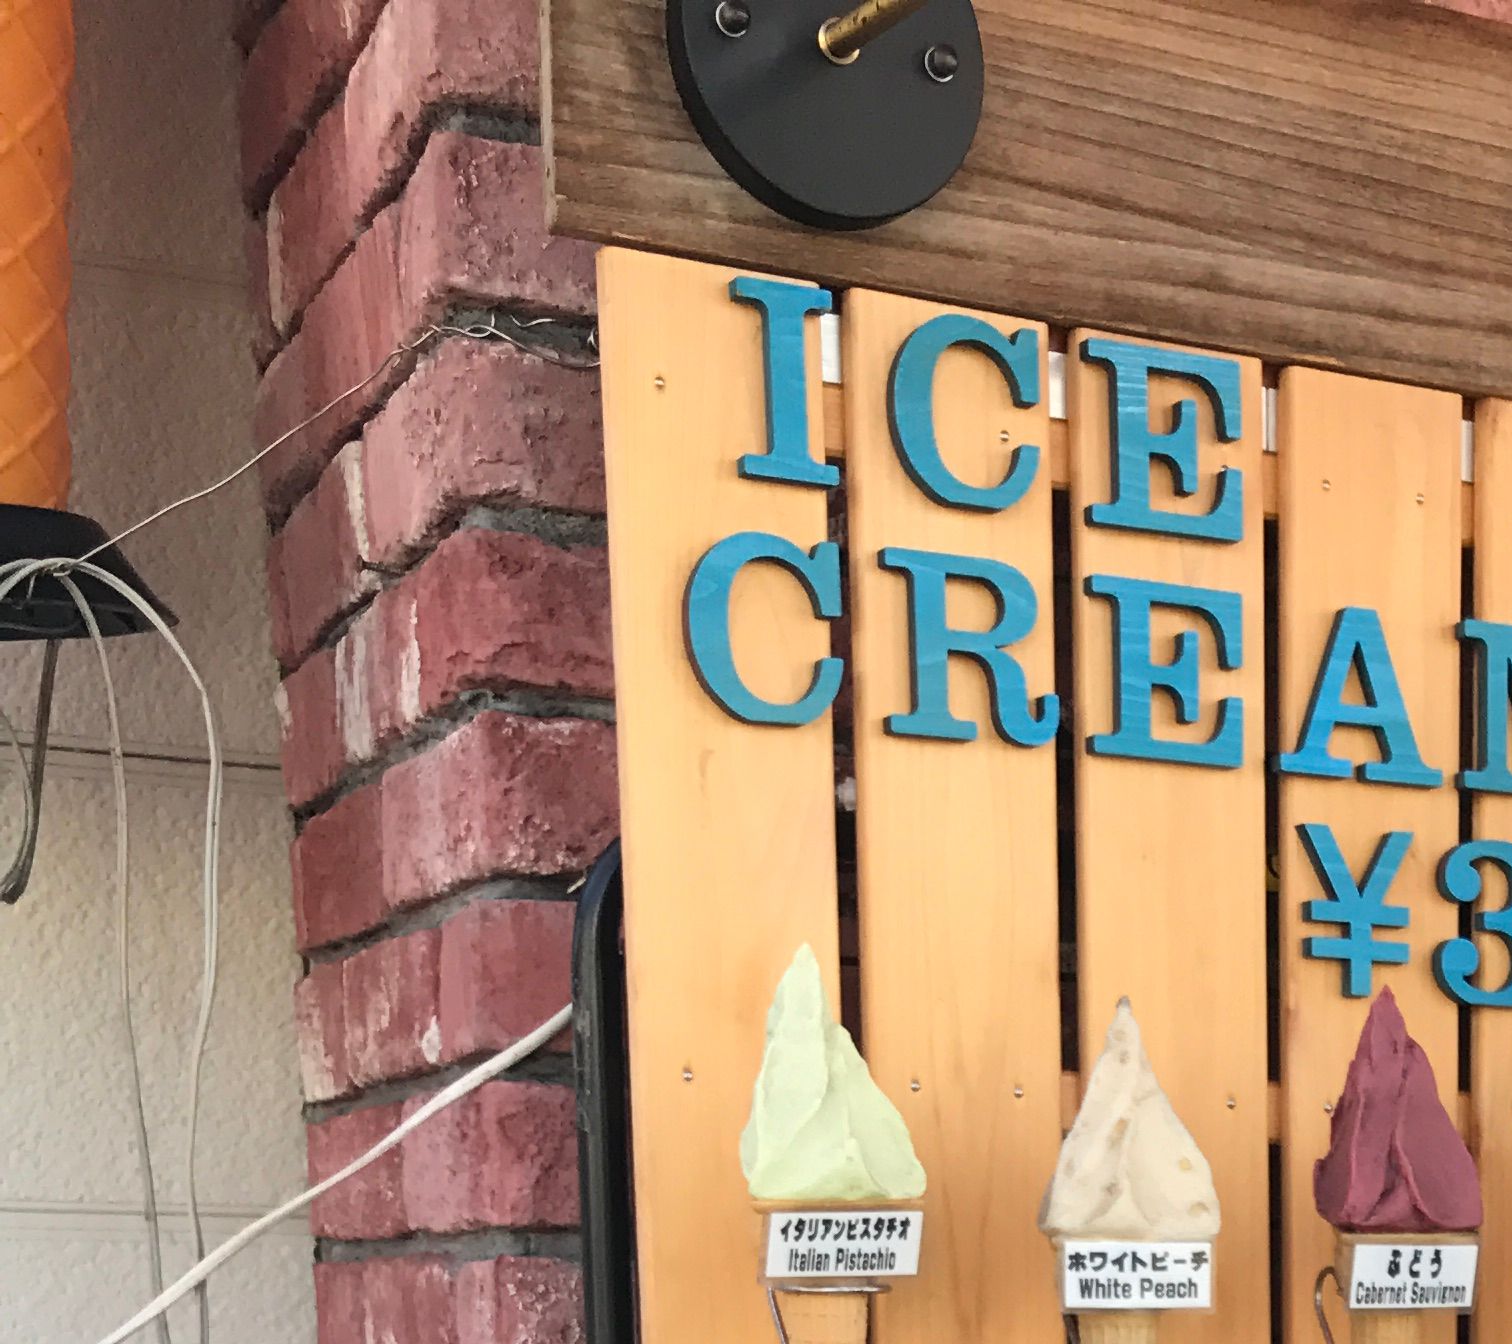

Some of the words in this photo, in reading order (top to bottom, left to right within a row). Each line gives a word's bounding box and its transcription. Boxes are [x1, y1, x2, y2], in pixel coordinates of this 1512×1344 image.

[729, 276, 1243, 545] ICE
[779, 1216, 912, 1244] イタリアンピスタチオ
[787, 1247, 831, 1272] Italian
[834, 1246, 897, 1272] Pistachio
[1066, 1250, 1210, 1272] ホワイトピーチ
[1384, 1249, 1443, 1280] ぶどう
[1078, 1276, 1133, 1300] White
[1138, 1276, 1199, 1300] Peach
[1355, 1281, 1405, 1306] Cabernet
[1410, 1281, 1467, 1306] Sauvignon
